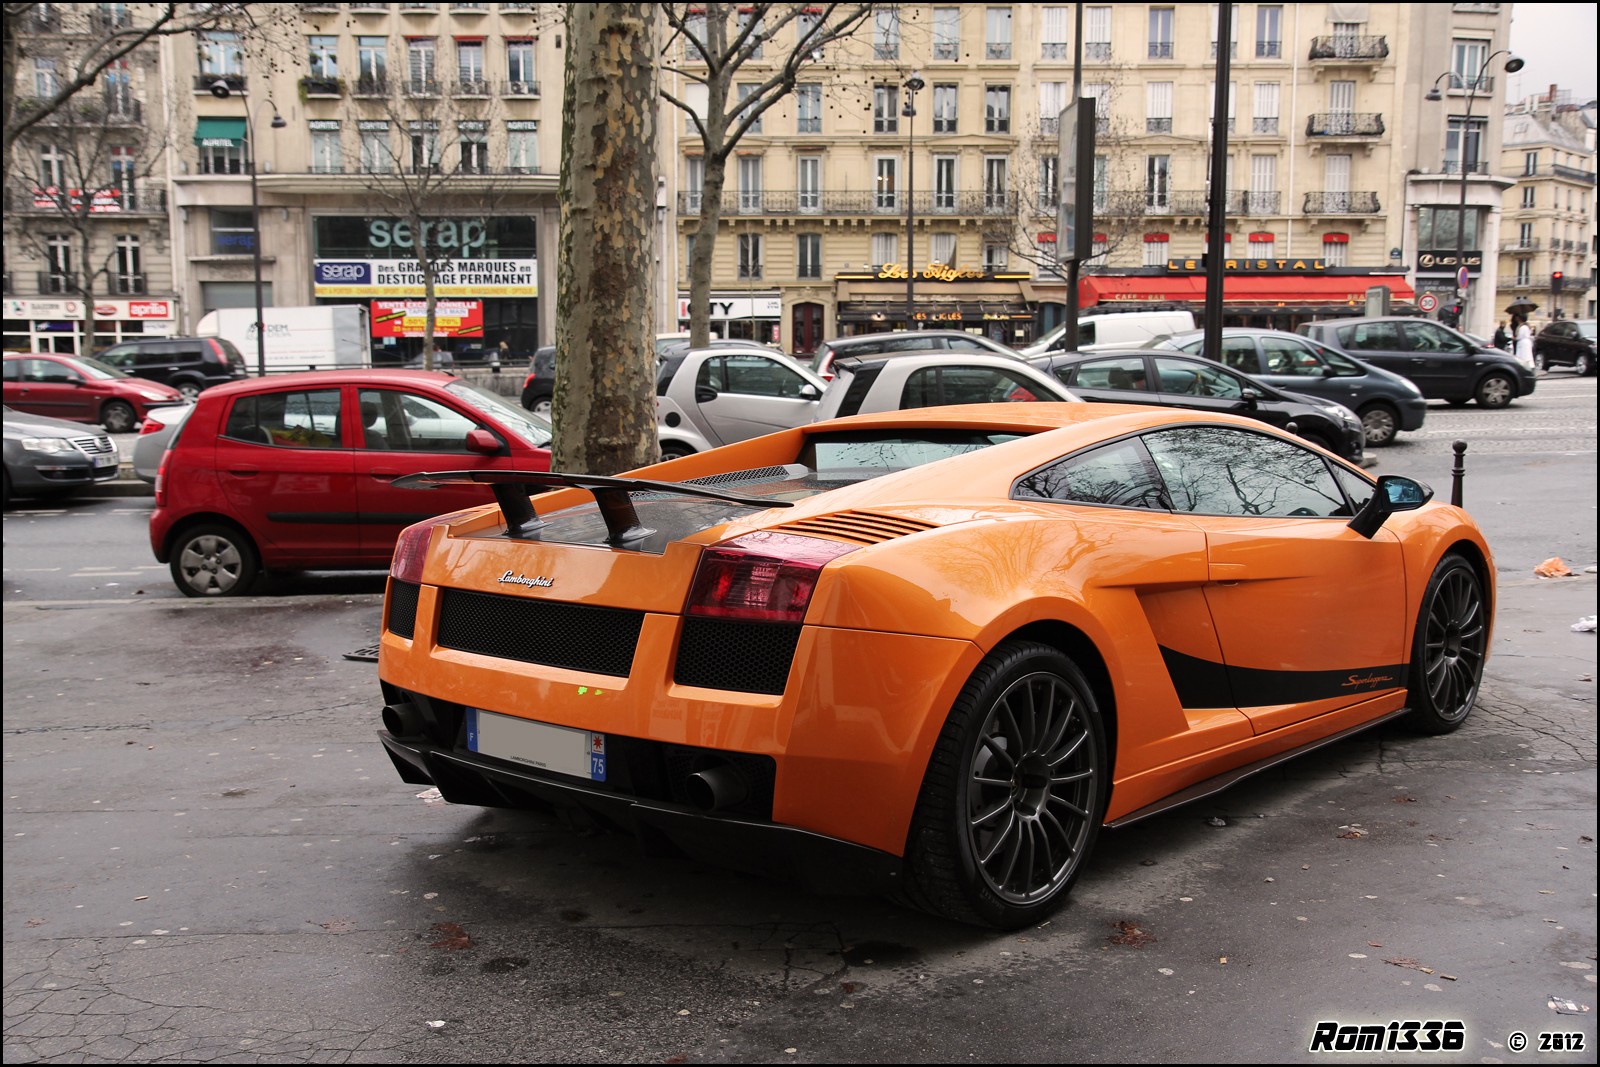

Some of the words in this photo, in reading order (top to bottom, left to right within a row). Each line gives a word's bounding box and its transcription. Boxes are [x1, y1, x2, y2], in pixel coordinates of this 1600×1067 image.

[369, 220, 487, 258] serap
[322, 263, 365, 281] serap
[378, 265, 395, 273] Des
[398, 261, 454, 273] GRADES
[458, 261, 516, 274] MARQUES
[519, 265, 532, 273] en
[923, 262, 986, 282] Aigles
[1168, 260, 1196, 270] LE
[1225, 260, 1325, 270] RISTAL
[378, 273, 456, 285] DESTOCAGE
[460, 273, 532, 285] PERMANENT
[131, 302, 167, 316] aprilia
[1422, 299, 1433, 307] 30
[497, 569, 554, 588] Lamborghini
[469, 732, 474, 741] F
[592, 757, 604, 775] 75
